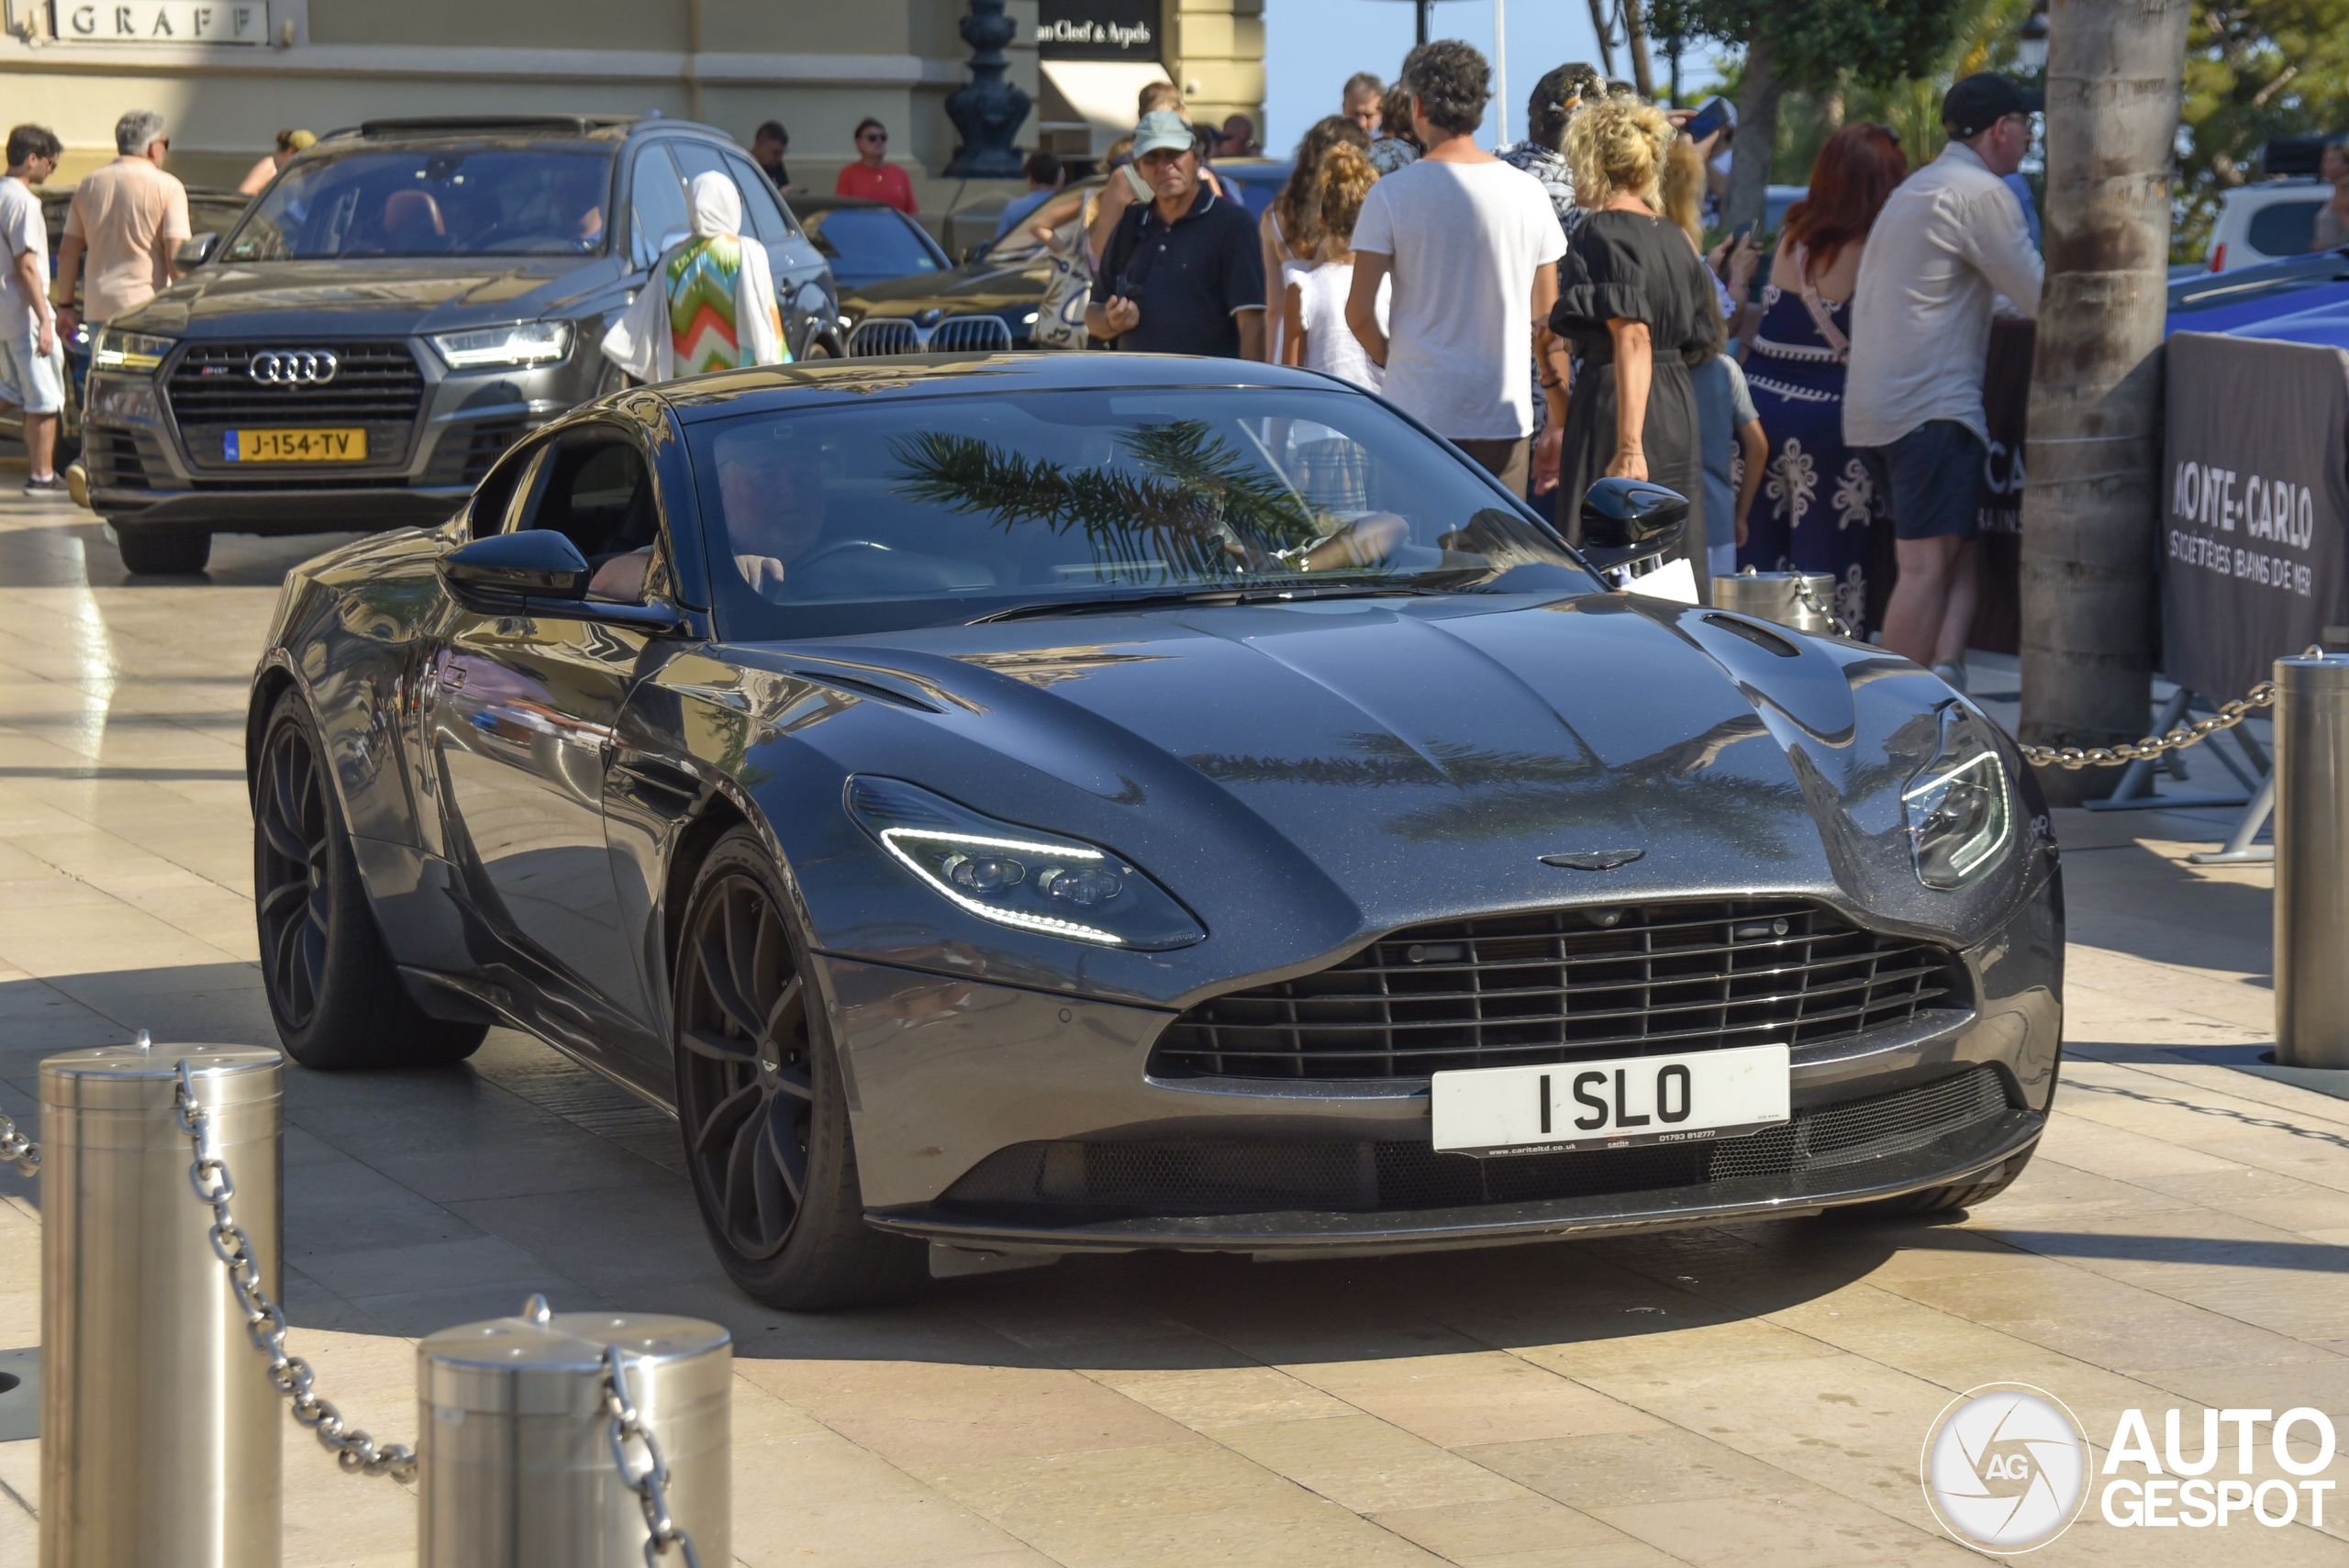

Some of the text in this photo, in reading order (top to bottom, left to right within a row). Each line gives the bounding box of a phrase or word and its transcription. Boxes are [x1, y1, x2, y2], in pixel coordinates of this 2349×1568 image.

[72, 6, 250, 37] GRAFF
[1053, 19, 1094, 42] Cleef
[1093, 24, 1106, 43] &
[1107, 20, 1151, 50] Arpels
[251, 433, 349, 455] J-154-TV
[2271, 557, 2292, 590] DE
[1573, 1063, 1691, 1130] SLO
[1488, 1143, 1576, 1156] www.cariteltd.co.uk
[1659, 1130, 1716, 1142] 01793 812777
